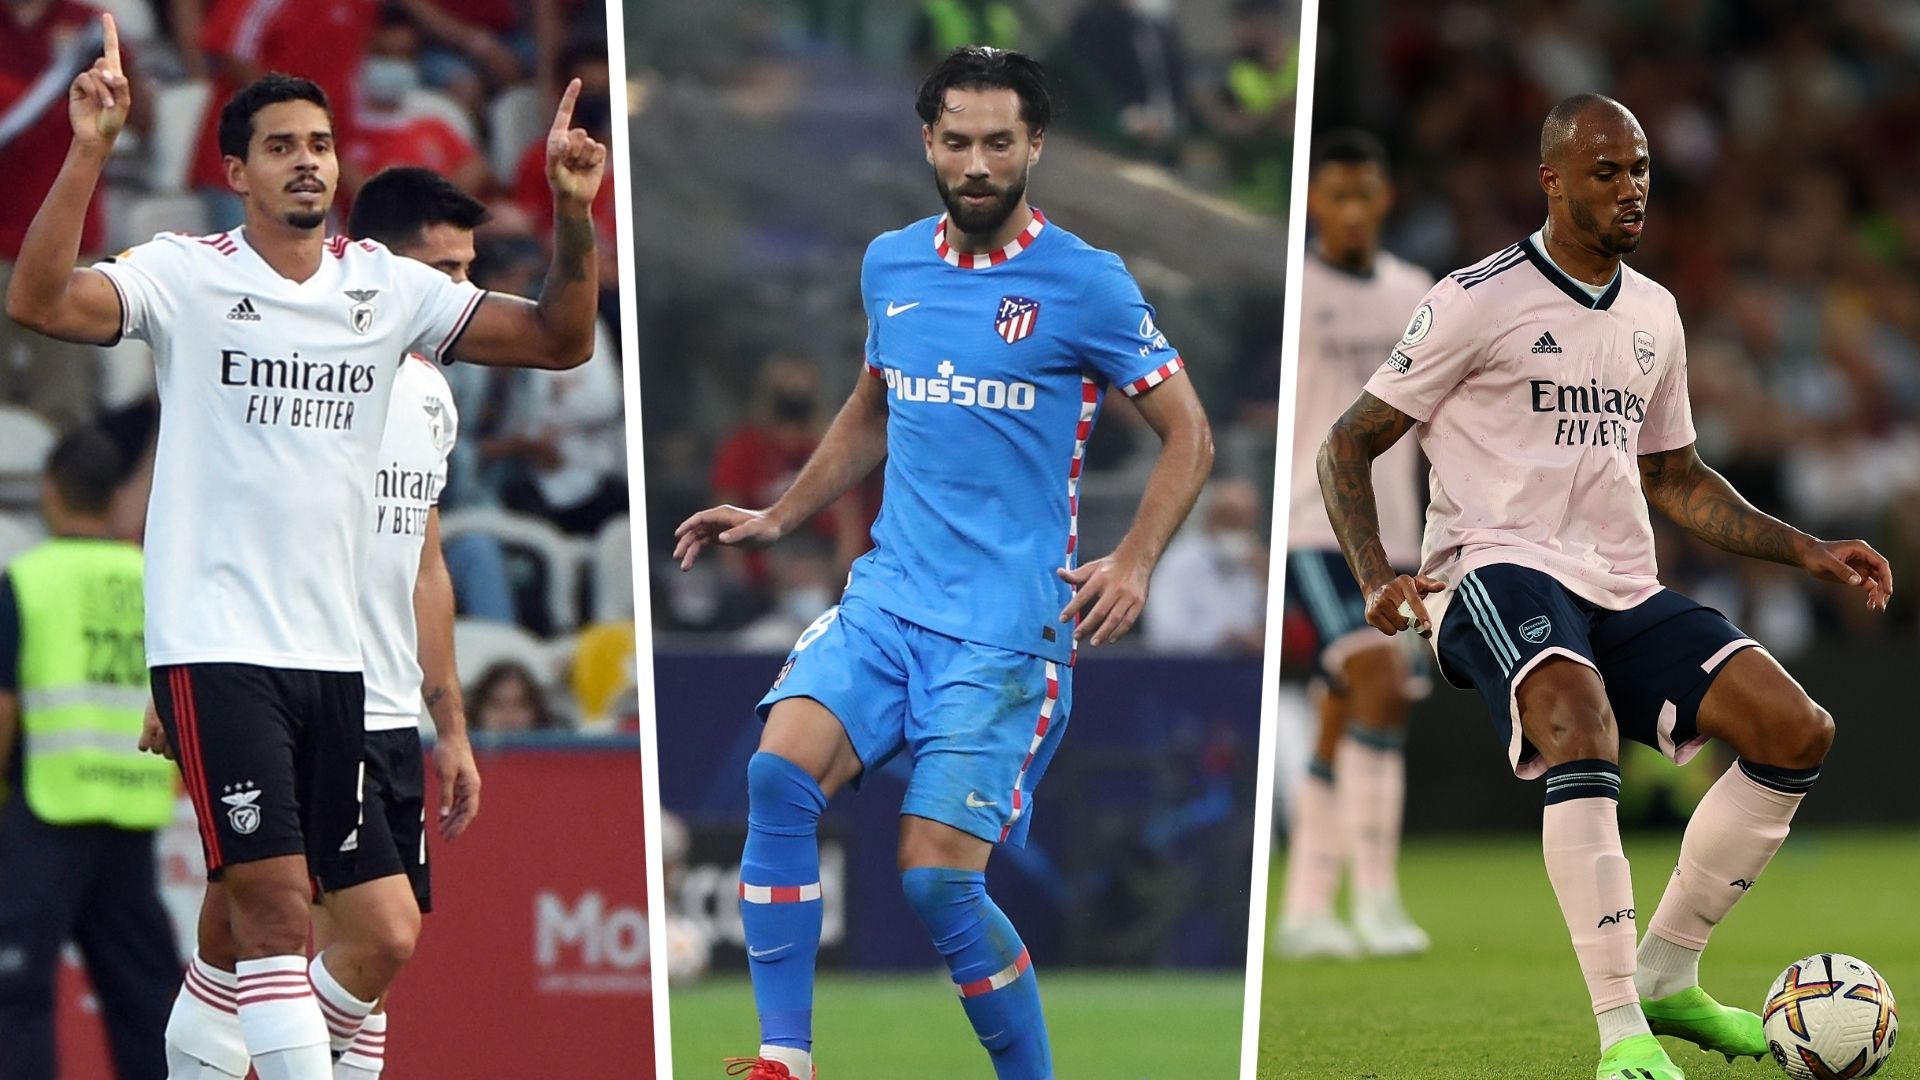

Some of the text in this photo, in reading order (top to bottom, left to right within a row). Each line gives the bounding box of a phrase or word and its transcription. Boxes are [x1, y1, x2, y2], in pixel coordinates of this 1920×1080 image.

[1531, 344, 1563, 354] adidas
[220, 349, 376, 394] Emirates
[883, 360, 1036, 411] Plus500
[246, 394, 355, 430] FLY BETTER
[1554, 418, 1589, 446] FLY
